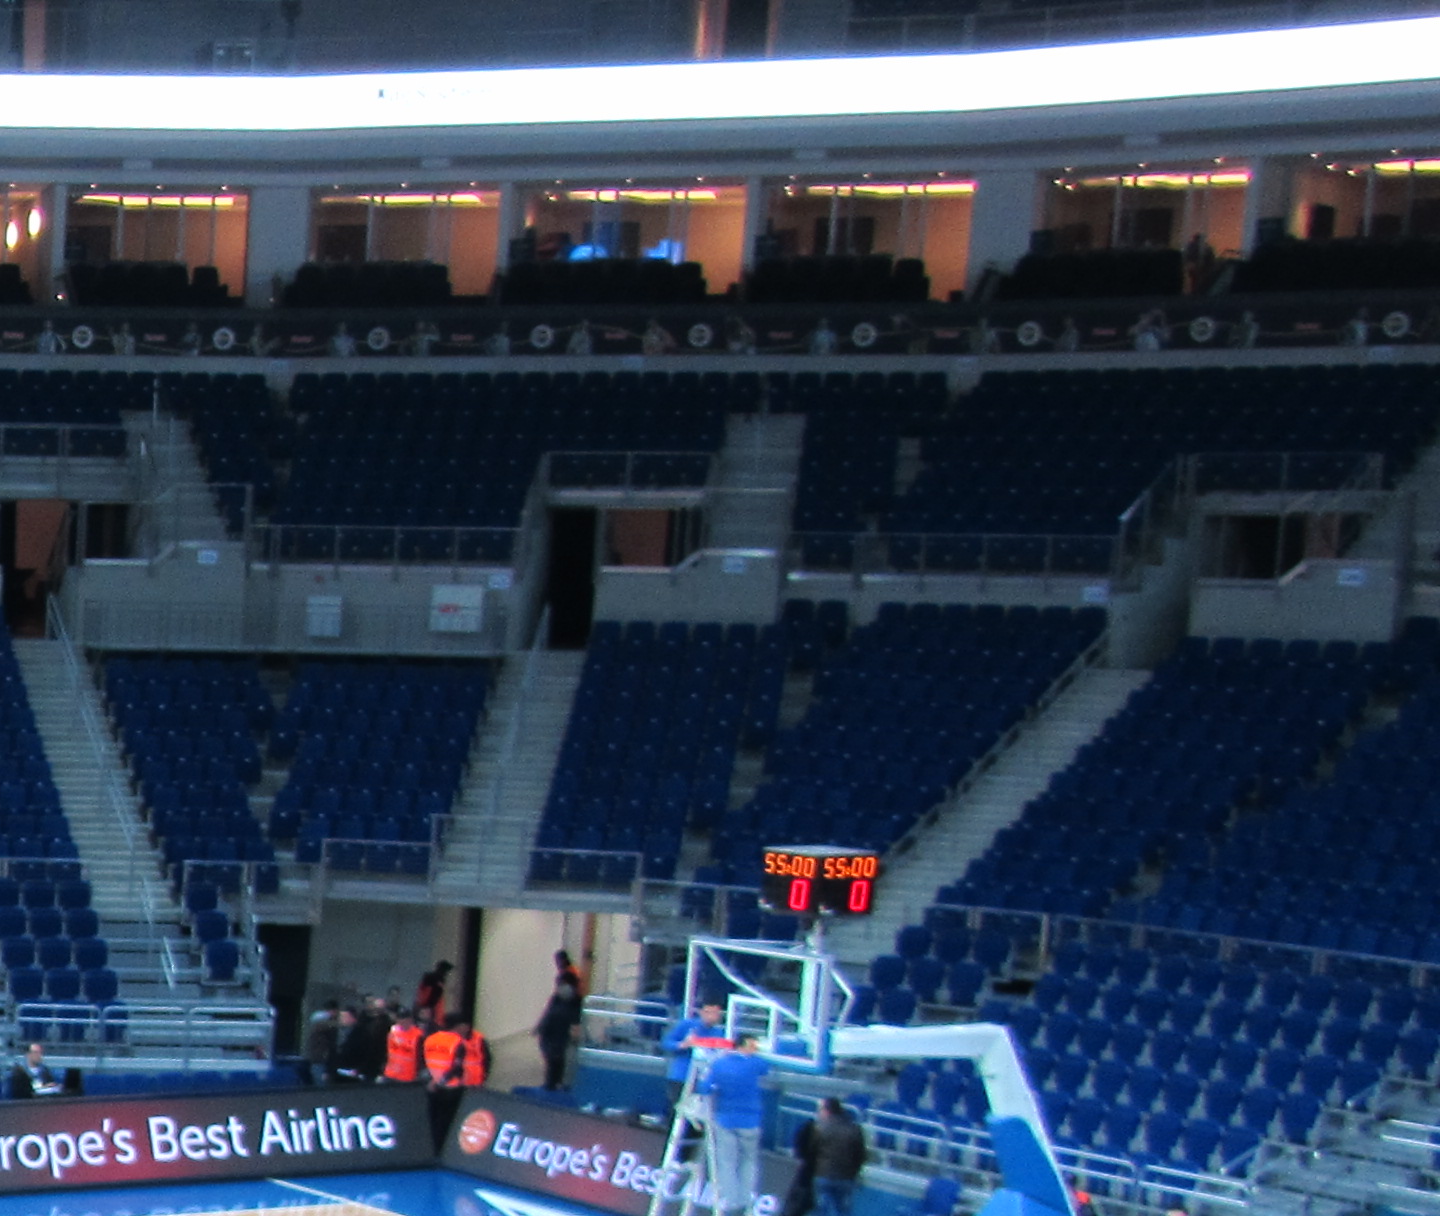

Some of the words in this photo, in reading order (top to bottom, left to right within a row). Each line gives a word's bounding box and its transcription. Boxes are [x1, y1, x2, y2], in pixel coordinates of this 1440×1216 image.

[764, 852, 817, 879] 55:00
[823, 857, 878, 879] 55:00
[788, 878, 810, 911] 0
[848, 880, 870, 912] 0
[147, 1115, 250, 1163] Best
[260, 1106, 396, 1156] Airline
[492, 1121, 611, 1179] Europe's
